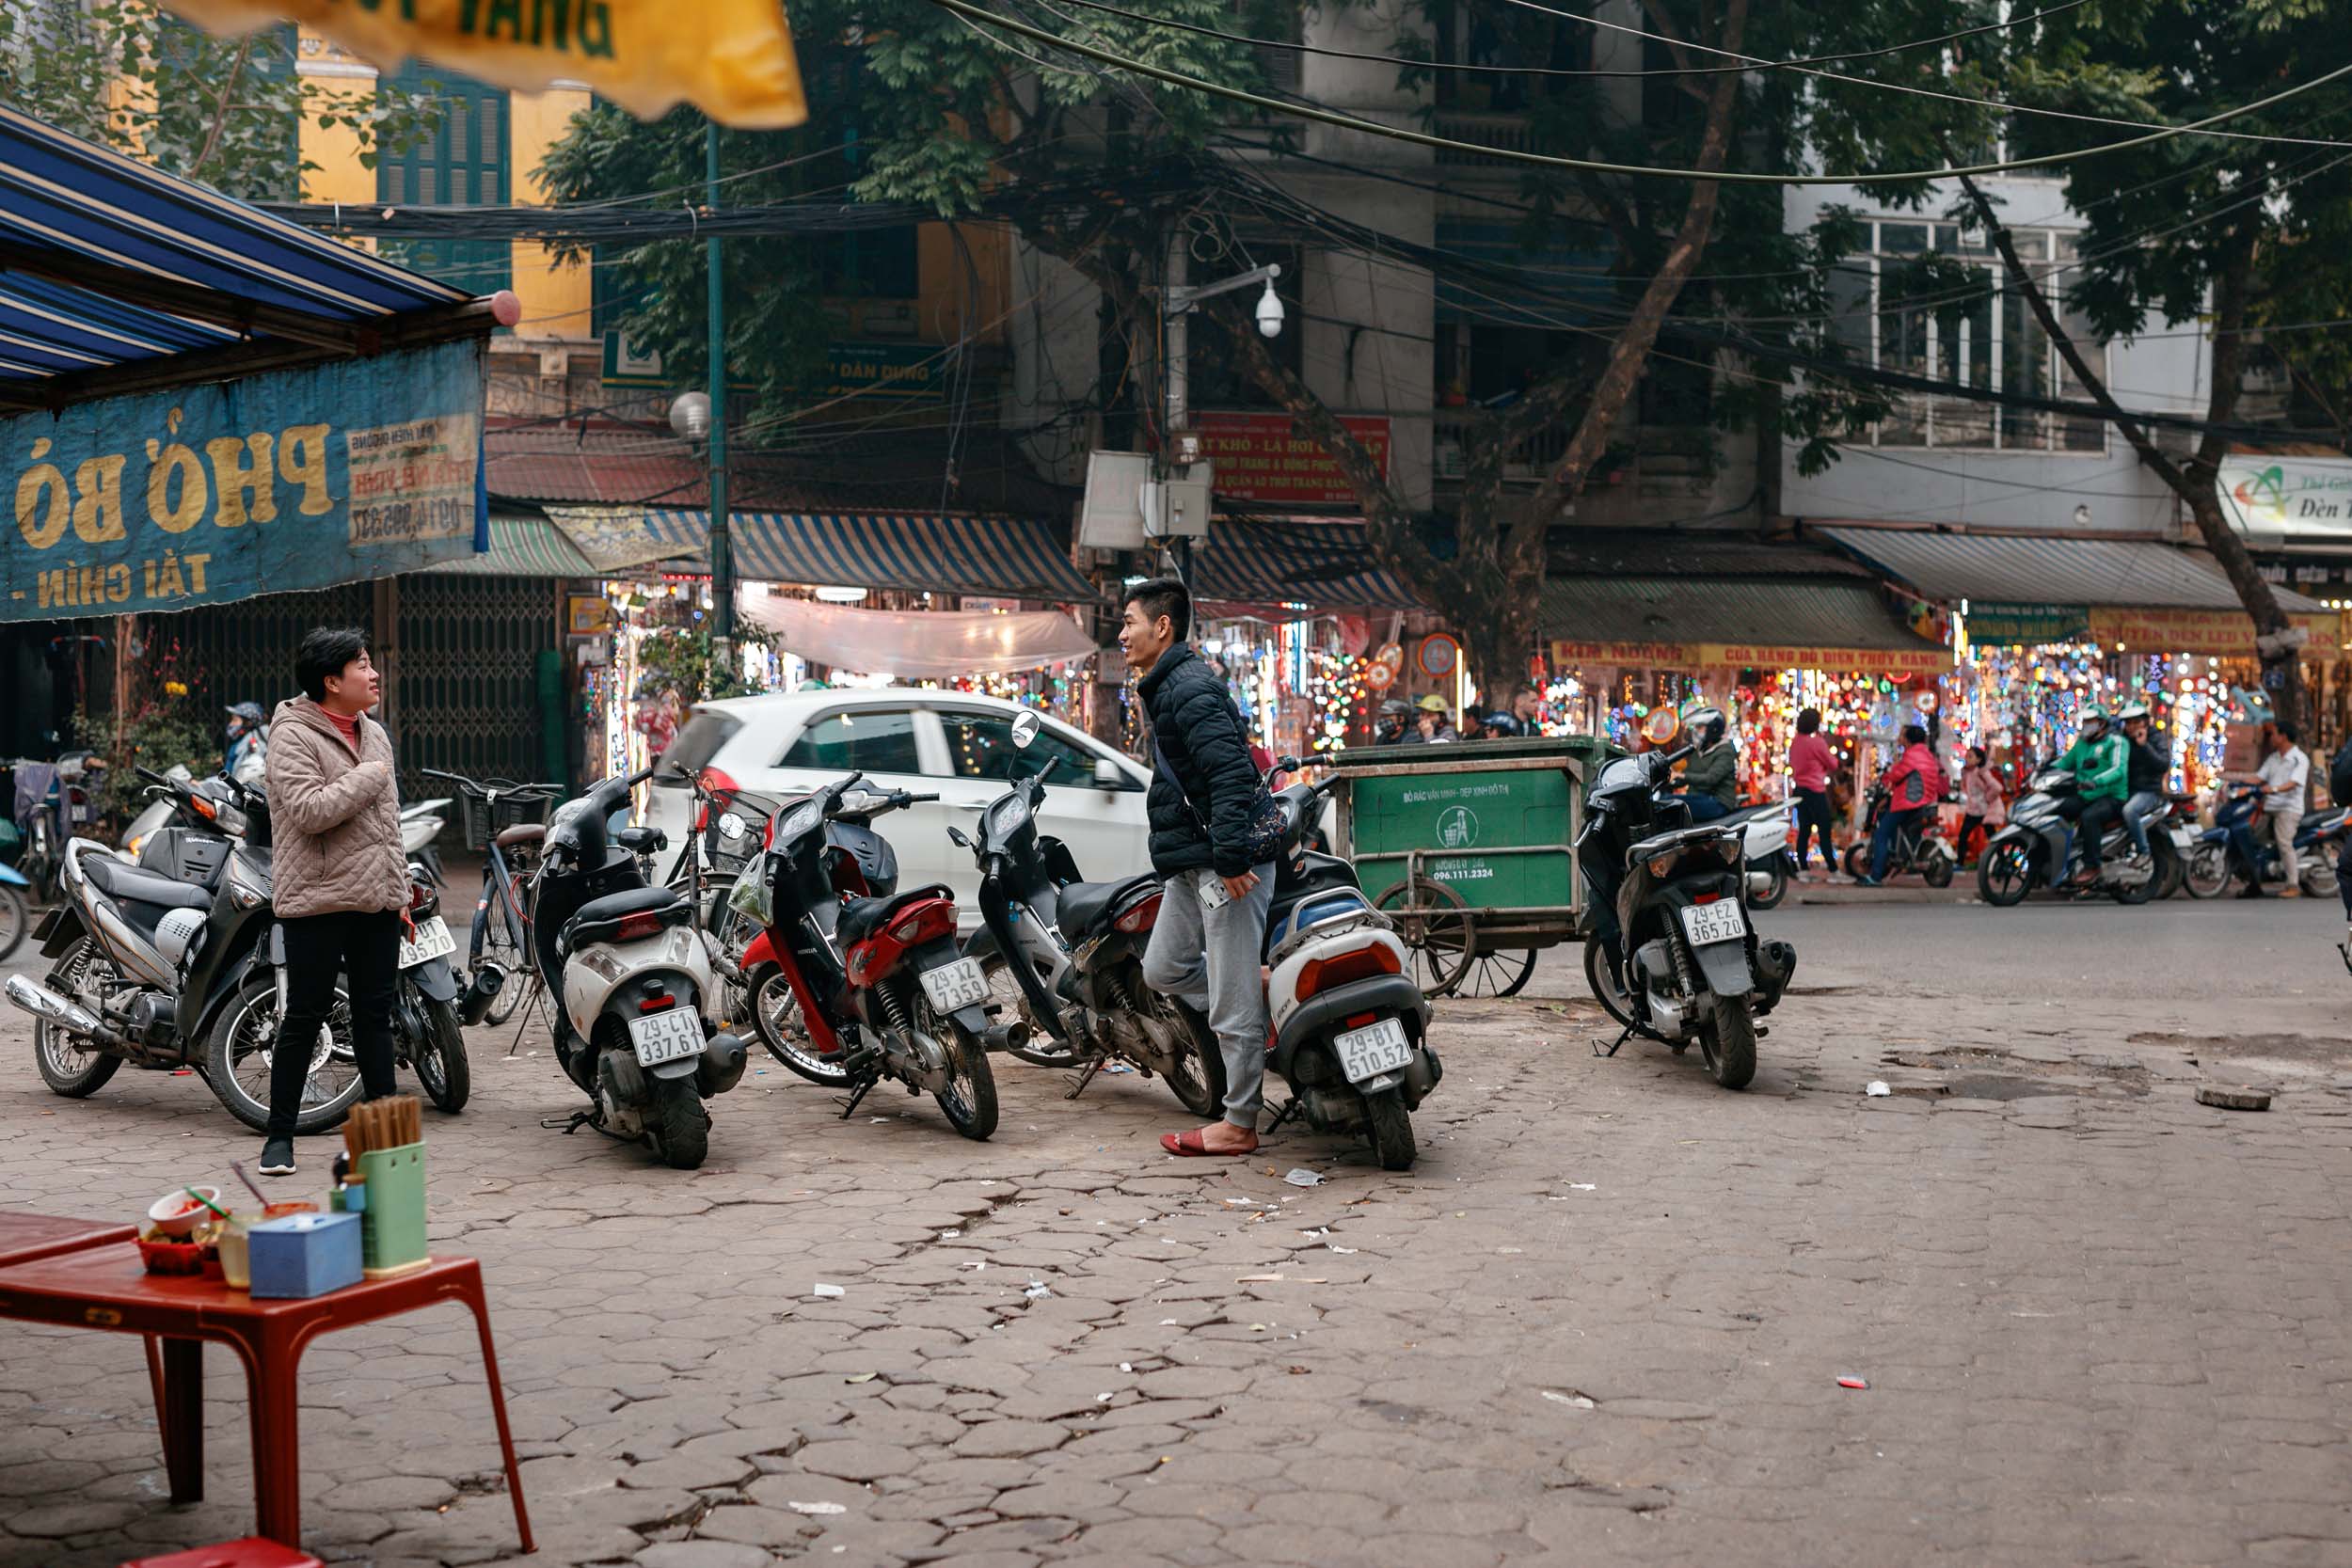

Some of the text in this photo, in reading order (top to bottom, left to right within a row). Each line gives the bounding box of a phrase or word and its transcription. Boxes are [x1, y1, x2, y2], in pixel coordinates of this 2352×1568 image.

[1434, 869, 1494, 880] 096.111.2324
[1692, 903, 1733, 924] 29-E2
[1692, 919, 1741, 942] 365.20
[930, 962, 976, 991] 29-X2
[938, 981, 984, 1011] 7359
[641, 1012, 688, 1039] 29-C1
[1345, 1024, 1393, 1056] 29-B1
[642, 1033, 701, 1062] 337.61
[1347, 1043, 1407, 1078] 510.52
